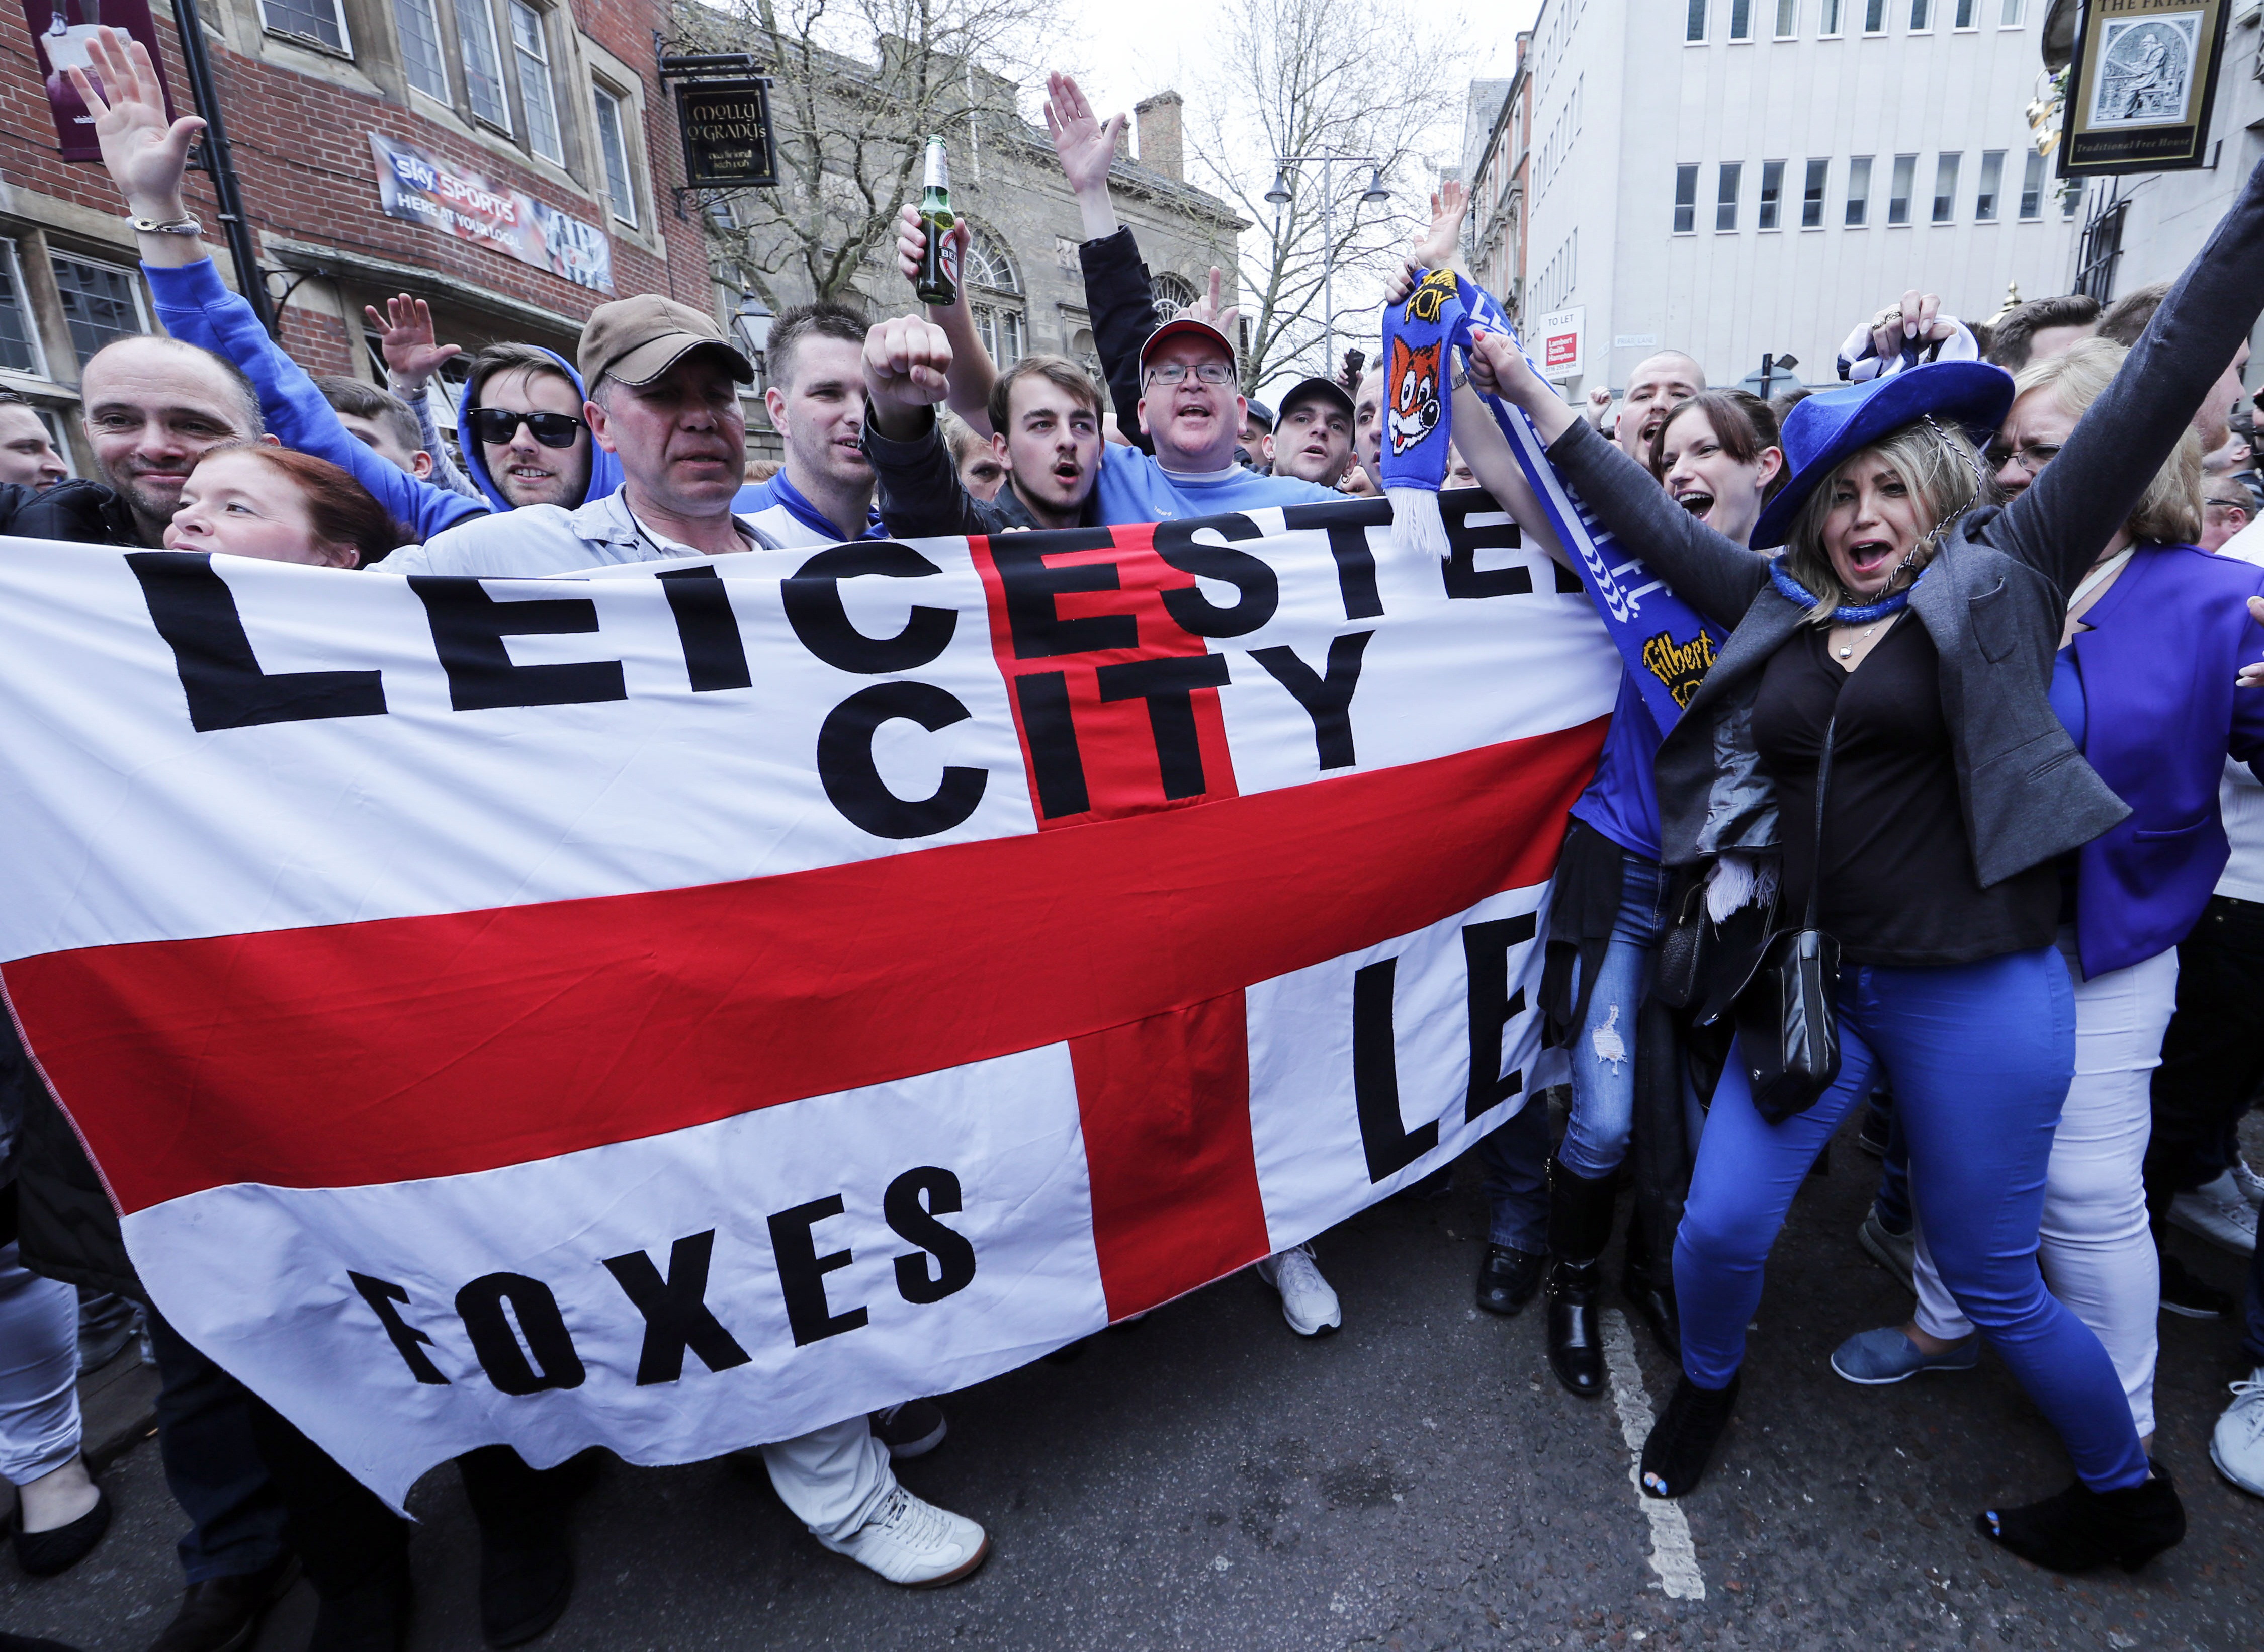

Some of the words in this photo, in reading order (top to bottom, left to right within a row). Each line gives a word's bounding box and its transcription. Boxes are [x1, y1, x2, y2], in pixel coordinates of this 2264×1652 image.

[2100, 0, 2136, 12] THE
[694, 104, 755, 122] MOLLY
[2077, 140, 2134, 152] Traditional
[2136, 140, 2157, 148] Free
[2158, 138, 2191, 147] House
[396, 157, 434, 191] sky
[440, 175, 515, 223] SPORTS
[397, 192, 438, 217] HERE
[439, 206, 454, 223] AT
[455, 212, 489, 237] YOUR
[488, 226, 524, 250] LOCAL
[1548, 318, 1558, 326] TO
[1560, 314, 1574, 324] LET
[1549, 336, 1573, 347] Lambert
[1549, 345, 1565, 355] Smith
[1548, 352, 1574, 362] Hampton
[123, 488, 1593, 732] LEICESTE
[1643, 630, 1717, 686] Filbert
[1671, 679, 1704, 710] FO
[817, 630, 1376, 839] CITY
[347, 1166, 976, 1396] FOXES
